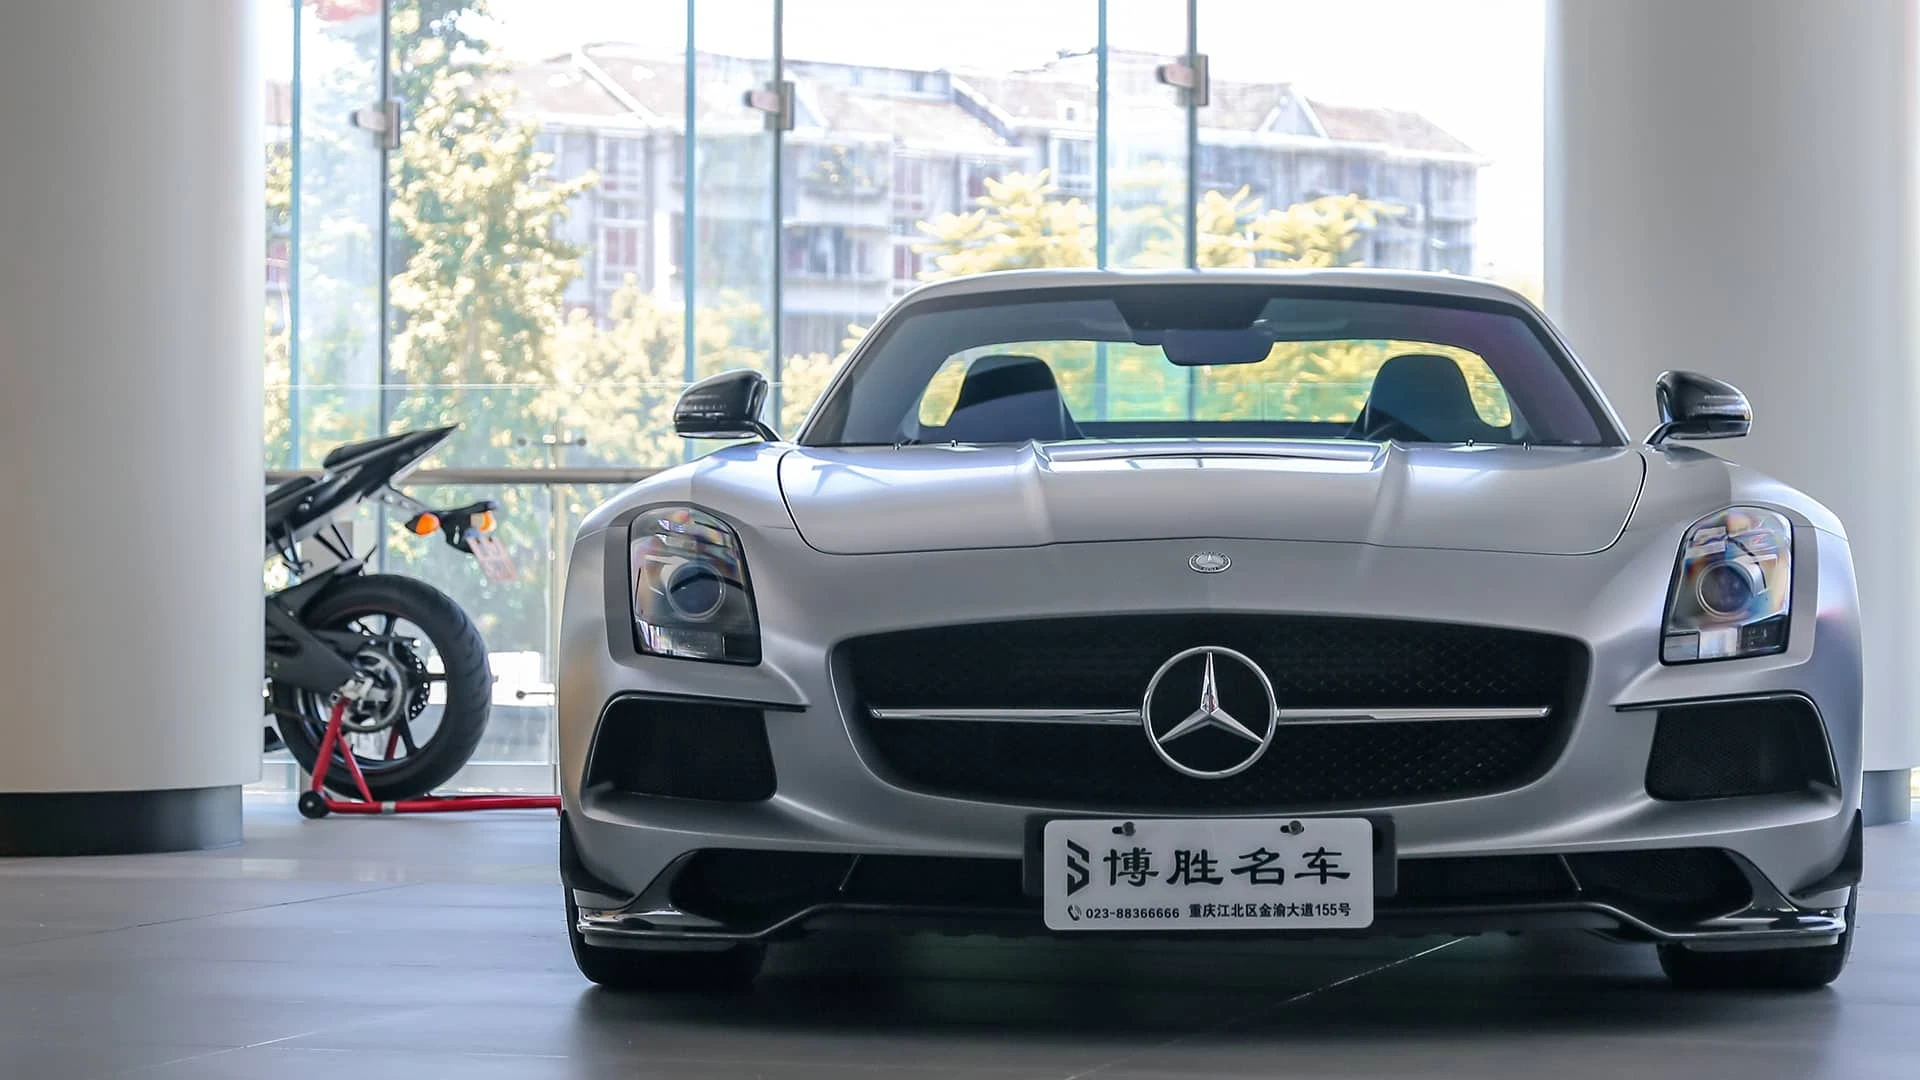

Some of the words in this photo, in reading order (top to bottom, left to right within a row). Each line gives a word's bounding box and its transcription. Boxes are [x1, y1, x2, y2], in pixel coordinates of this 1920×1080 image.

[1102, 846, 1351, 888] 博胜名车
[1085, 907, 1180, 919] 023-88366666
[1188, 902, 1352, 919] 重庆江北区金渝大道155号
